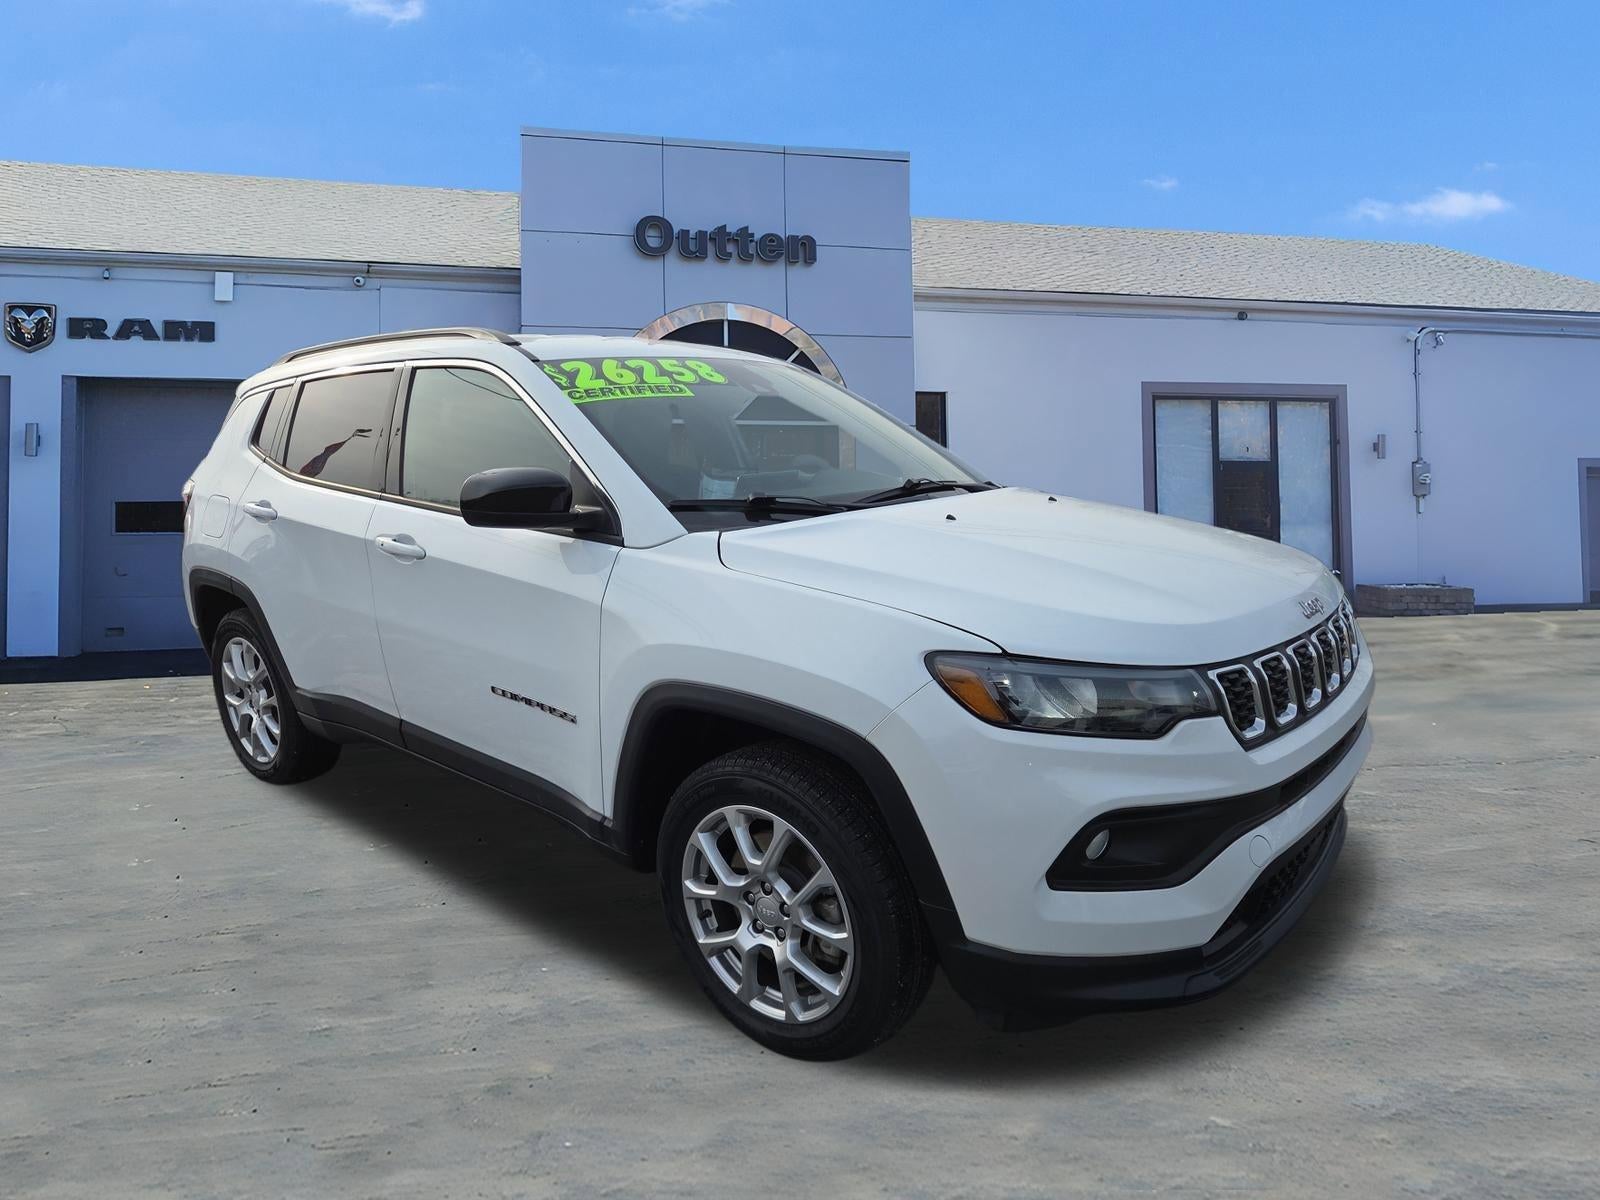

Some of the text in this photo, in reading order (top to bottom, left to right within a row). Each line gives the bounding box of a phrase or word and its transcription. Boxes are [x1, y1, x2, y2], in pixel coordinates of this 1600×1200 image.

[633, 215, 817, 264] Outten
[67, 317, 215, 342] RAM
[543, 359, 728, 389] $26258
[567, 384, 687, 400] CERTIFIED
